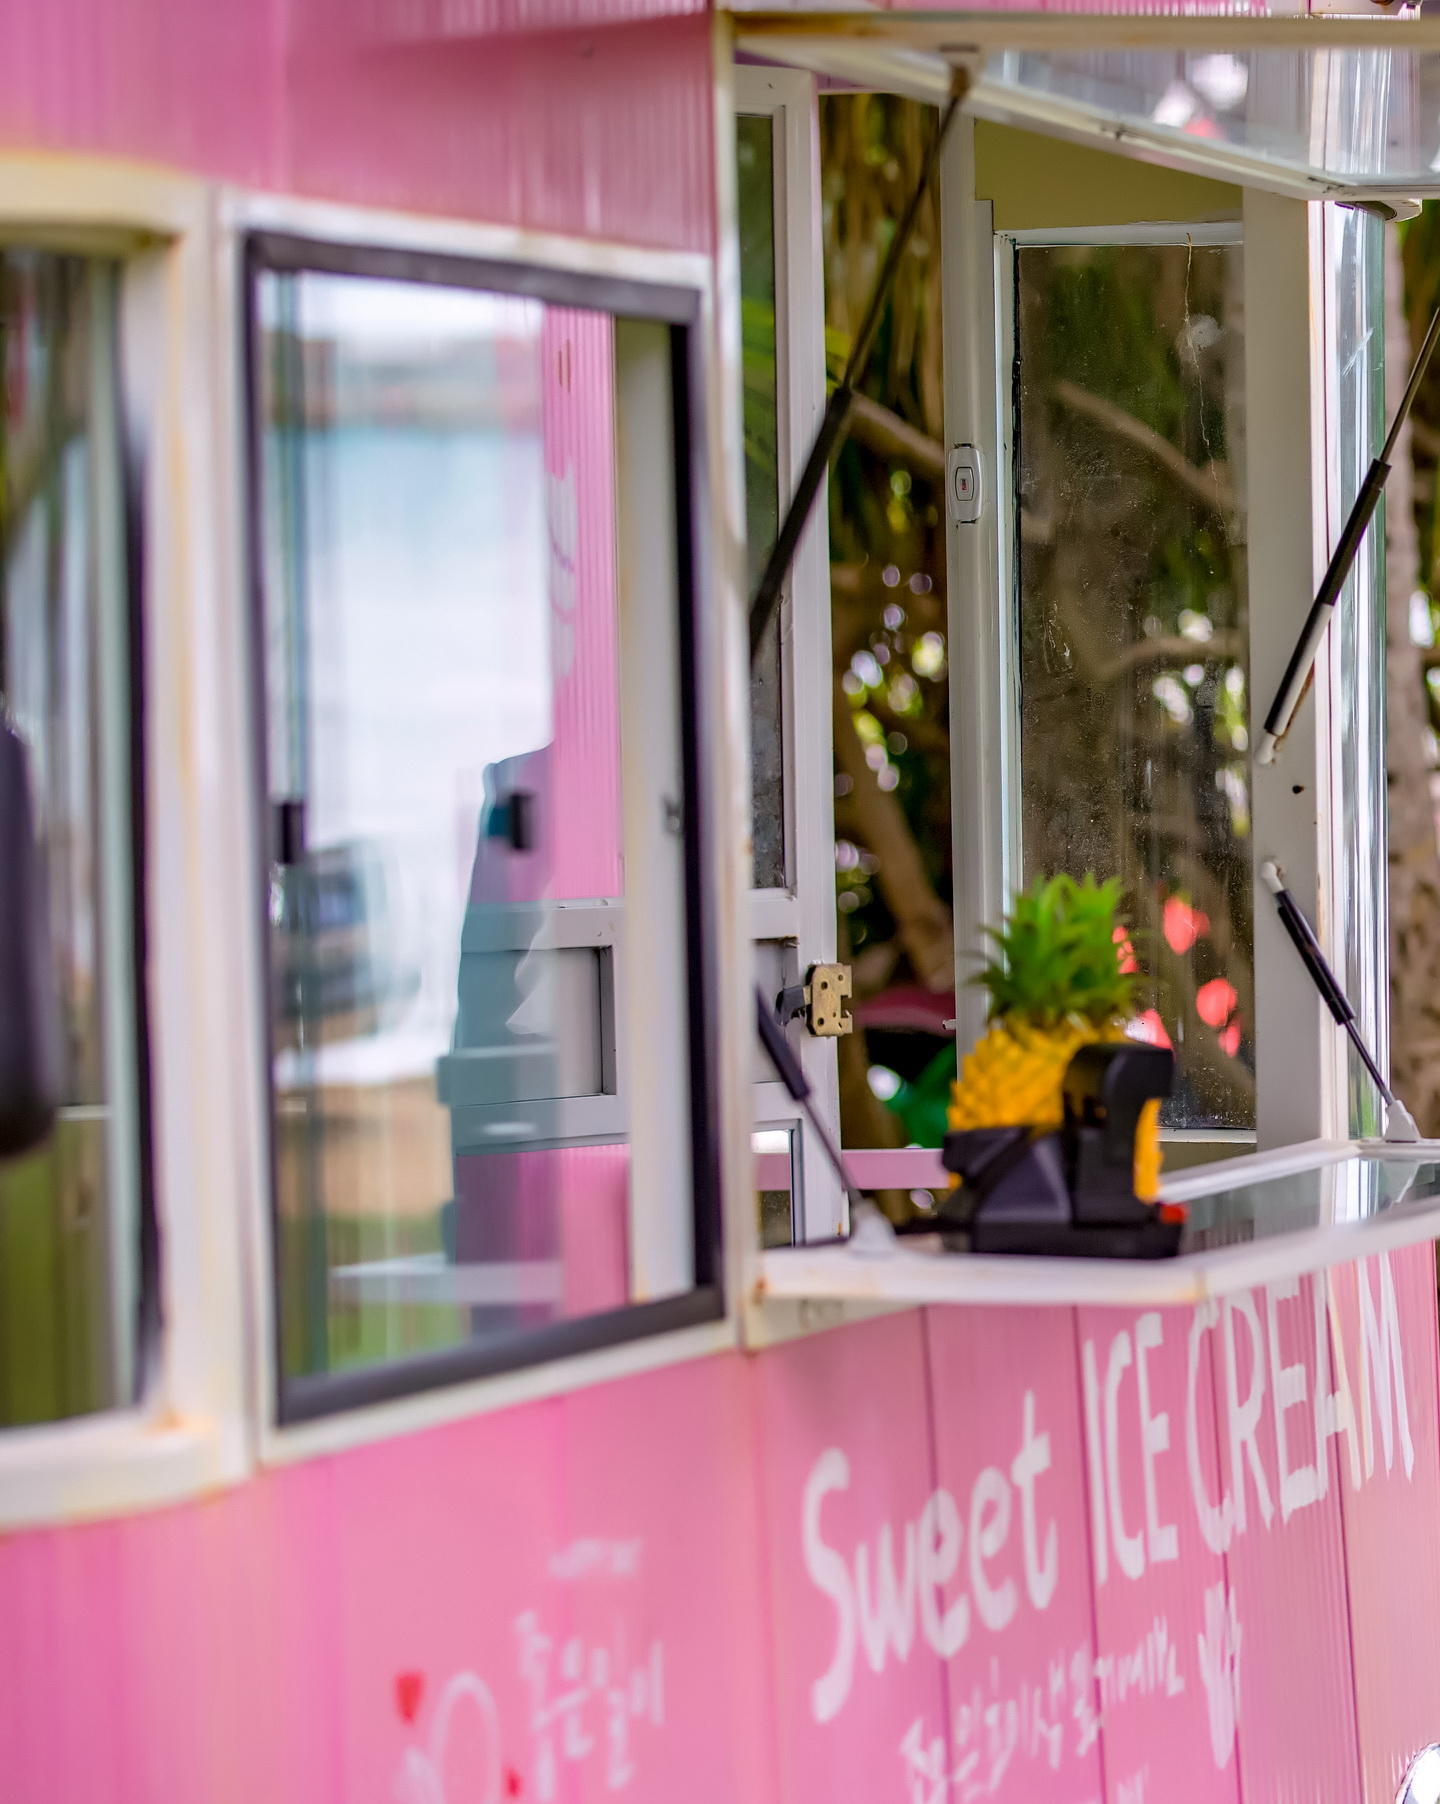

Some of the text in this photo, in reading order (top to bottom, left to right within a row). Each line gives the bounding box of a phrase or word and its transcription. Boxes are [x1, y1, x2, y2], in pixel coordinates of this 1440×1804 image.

[803, 1387, 1059, 1725] Sweet
[1083, 1311, 1179, 1587] ICE
[1186, 1249, 1414, 1555] CREAM
